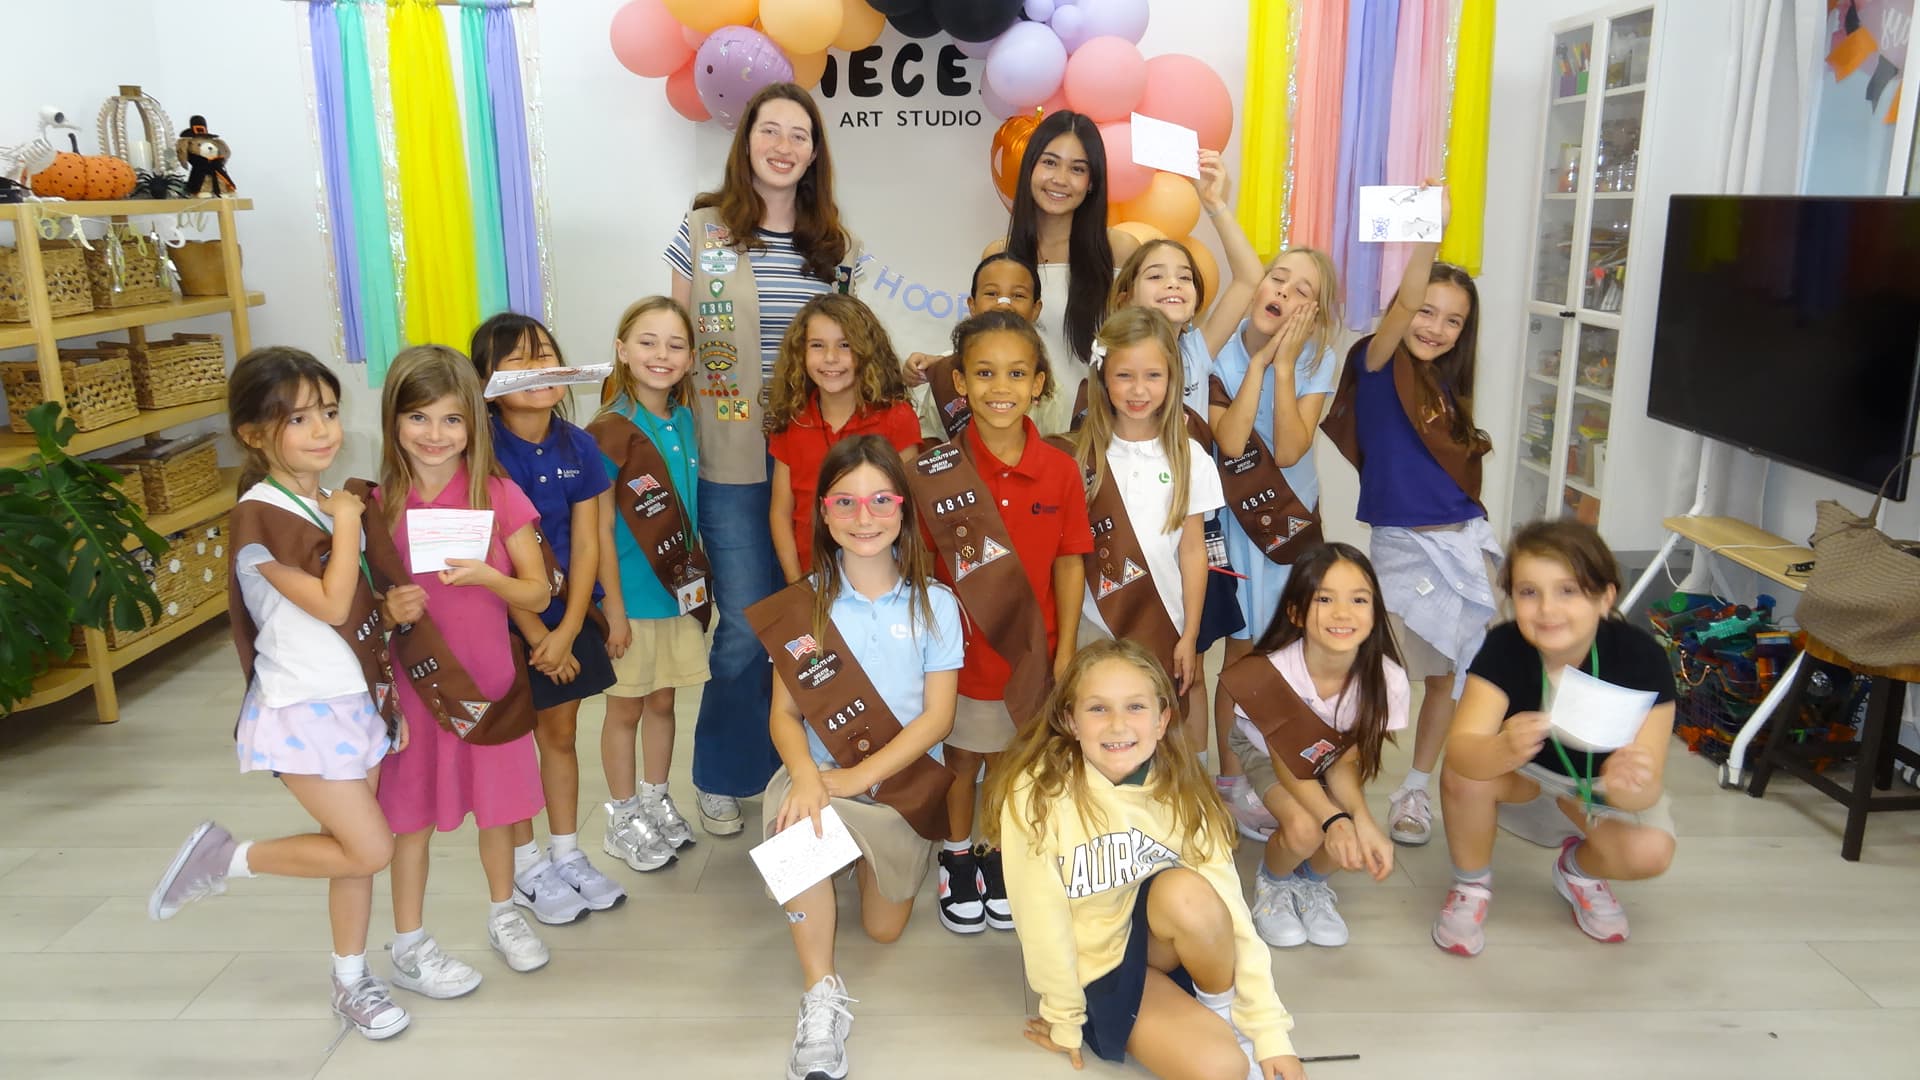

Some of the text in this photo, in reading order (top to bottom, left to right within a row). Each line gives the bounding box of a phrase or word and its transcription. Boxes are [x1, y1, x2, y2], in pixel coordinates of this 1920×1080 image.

[820, 43, 973, 98] IECE
[840, 110, 982, 127] ART STUDIO
[936, 491, 976, 515] 4815
[1242, 488, 1276, 511] 4815
[657, 530, 684, 556] 4815
[357, 609, 379, 641] 4815
[411, 658, 438, 679] 4815
[828, 699, 865, 730] 4815
